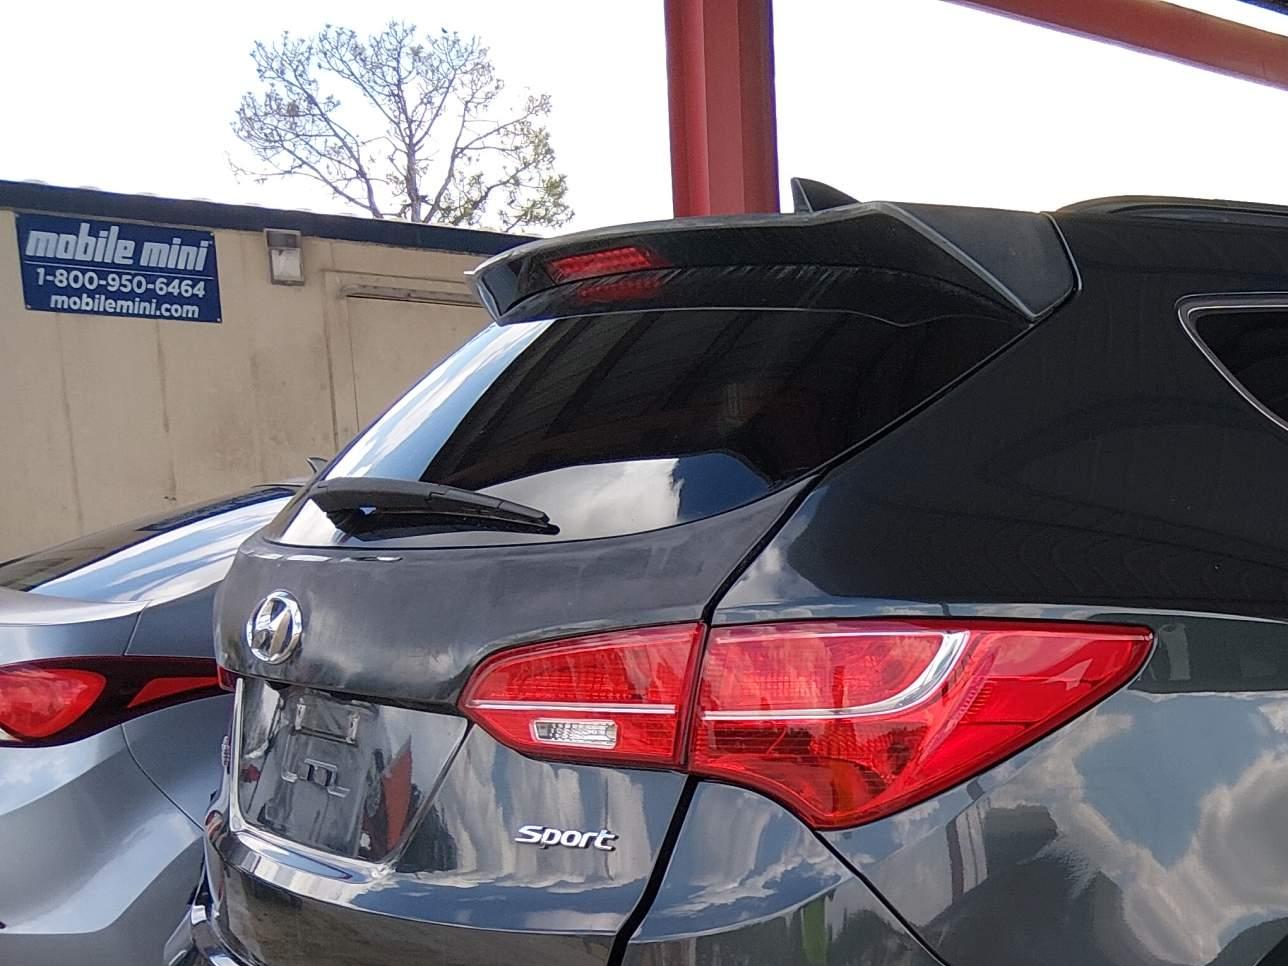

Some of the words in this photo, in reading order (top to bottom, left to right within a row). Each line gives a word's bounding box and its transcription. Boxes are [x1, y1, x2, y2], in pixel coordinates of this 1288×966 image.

[25, 222, 136, 265] mobile
[139, 237, 209, 271] mini
[36, 267, 206, 298] 1-800-950-6464
[50, 293, 200, 318] mobilemini.com
[514, 825, 616, 850] Sport
